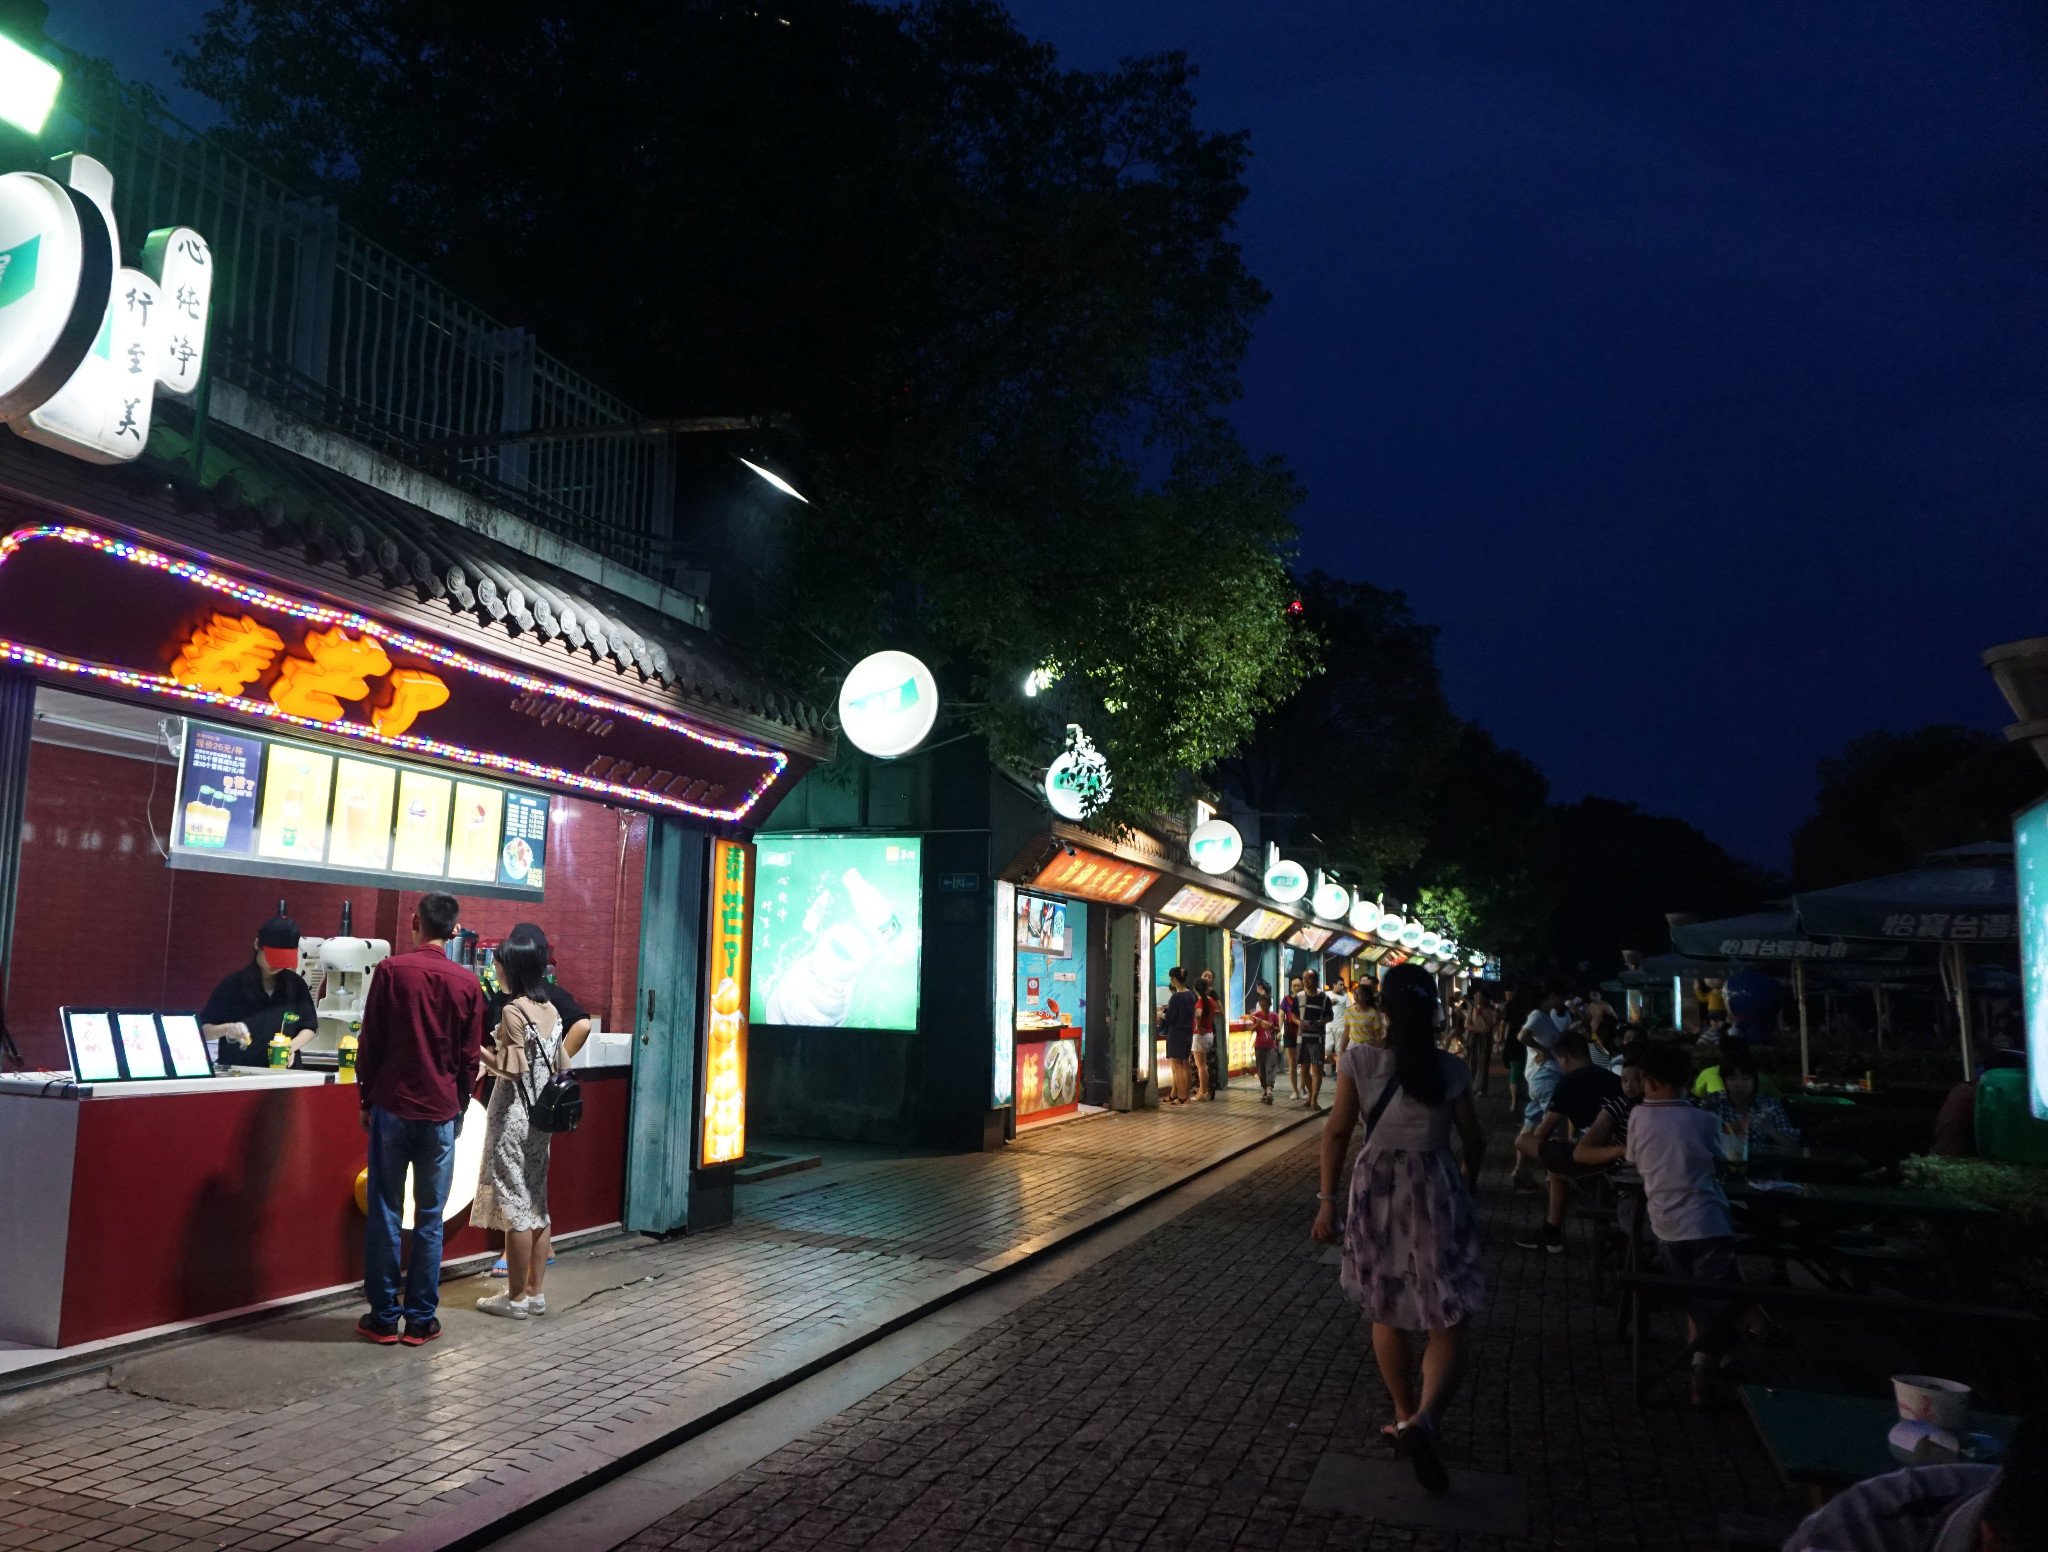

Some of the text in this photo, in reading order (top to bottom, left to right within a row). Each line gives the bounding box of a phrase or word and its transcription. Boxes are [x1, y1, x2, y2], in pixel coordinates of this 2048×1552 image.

[115, 287, 153, 442] 行至美
[169, 239, 211, 376] 心纯净
[171, 612, 450, 737] 泰芒了
[722, 845, 745, 977] 泰芒了
[1881, 913, 2018, 939] 怡寶台灣
